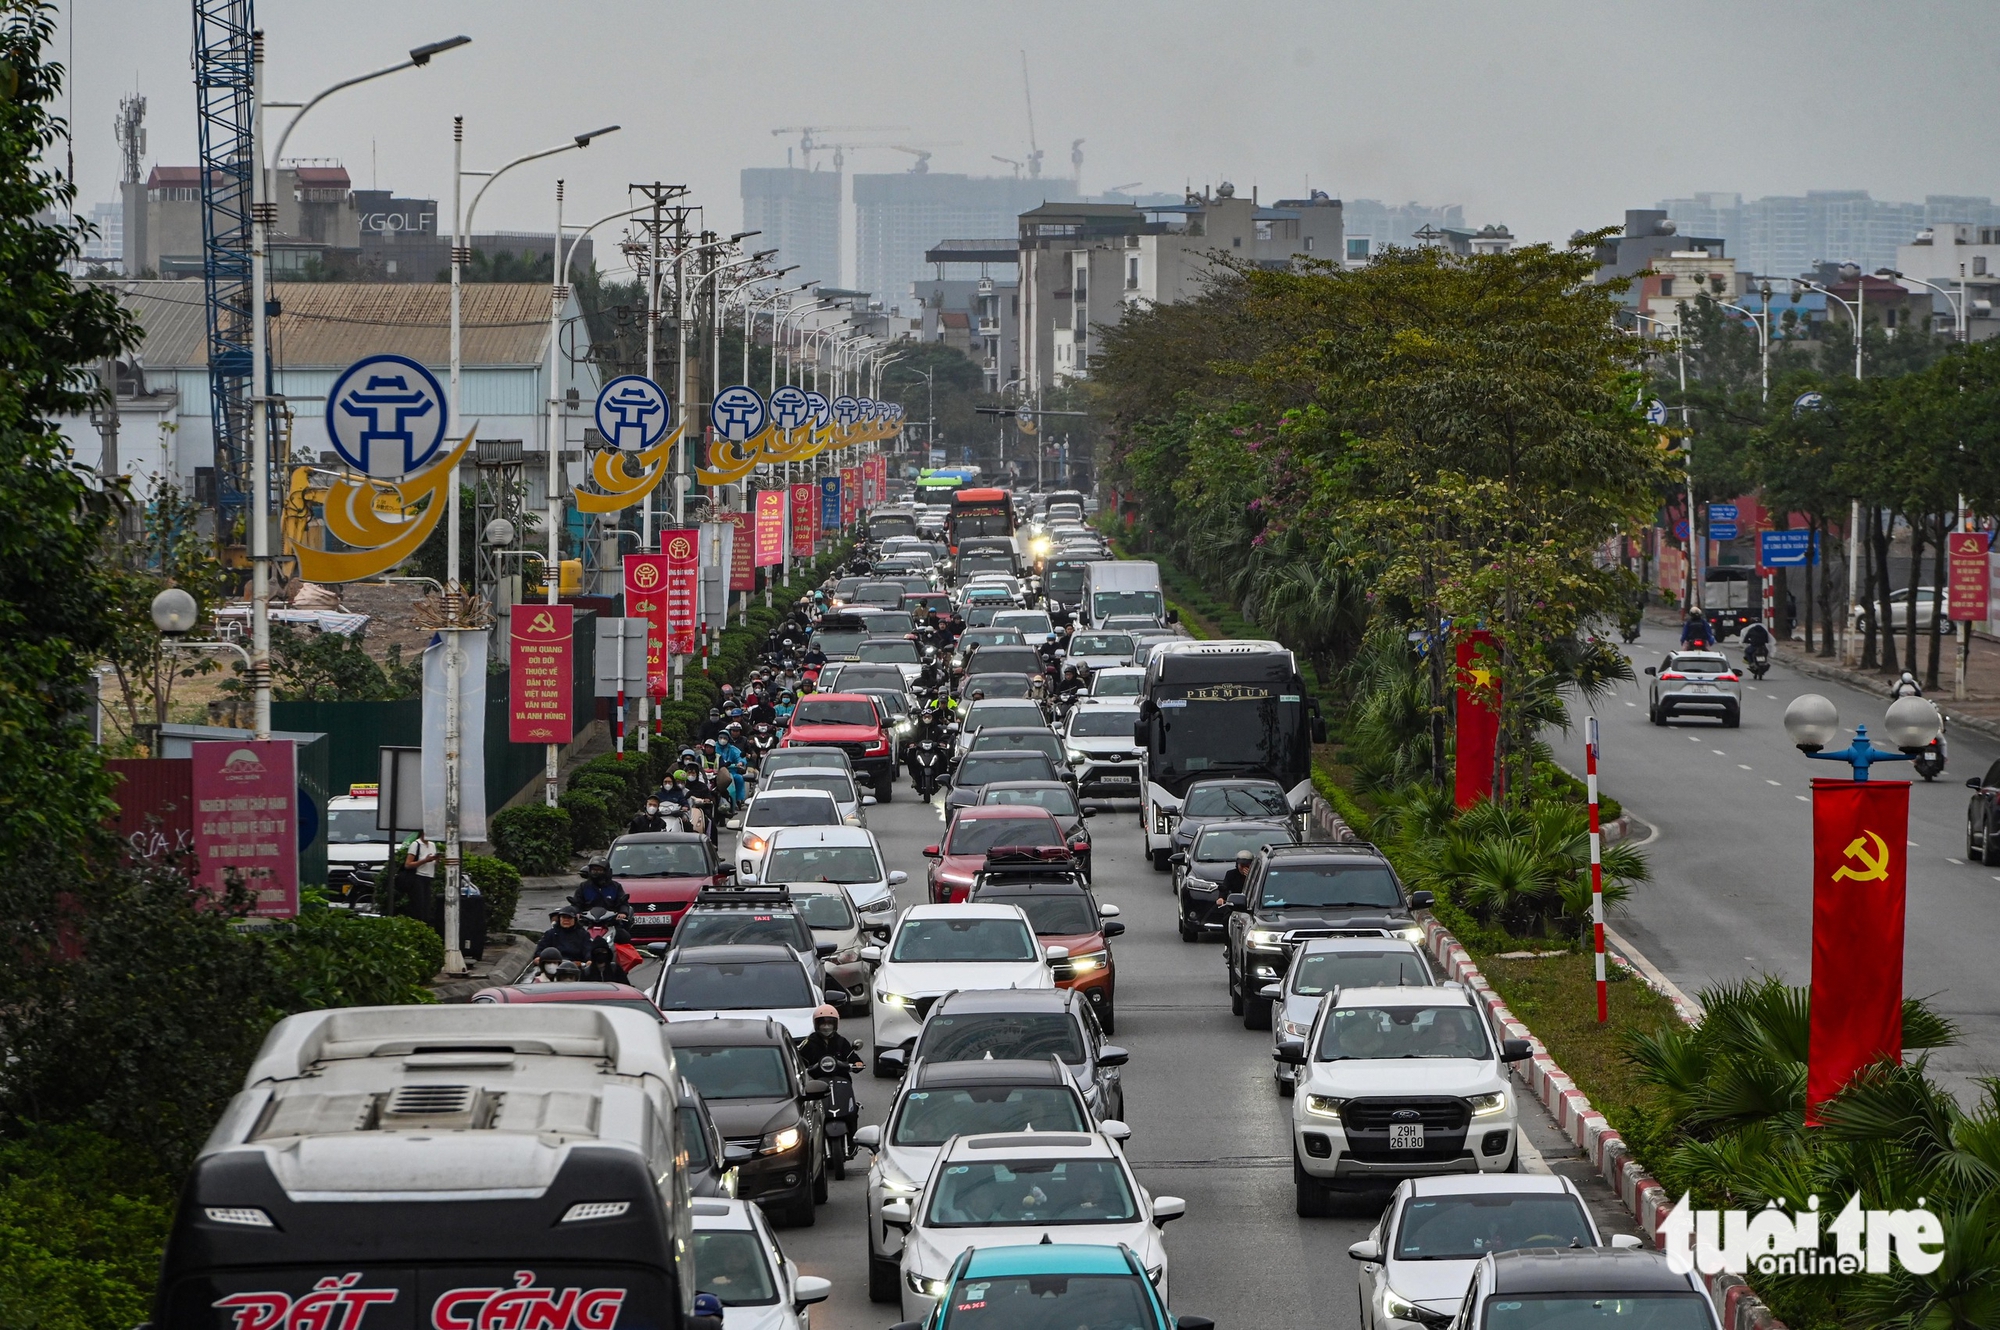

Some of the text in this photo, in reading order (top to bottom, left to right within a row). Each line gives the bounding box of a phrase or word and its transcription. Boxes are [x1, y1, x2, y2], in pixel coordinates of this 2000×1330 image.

[647, 656, 659, 664] 26
[524, 690, 539, 698] VIỆT
[1186, 689, 1269, 698] PREMIUM
[1399, 1110, 1414, 1119] Ford
[1398, 1126, 1416, 1136] 29H
[1391, 1138, 1423, 1148] 261.80
[212, 1270, 627, 1330] ĐẤT CẢNG
[957, 1301, 987, 1312] TAXI
